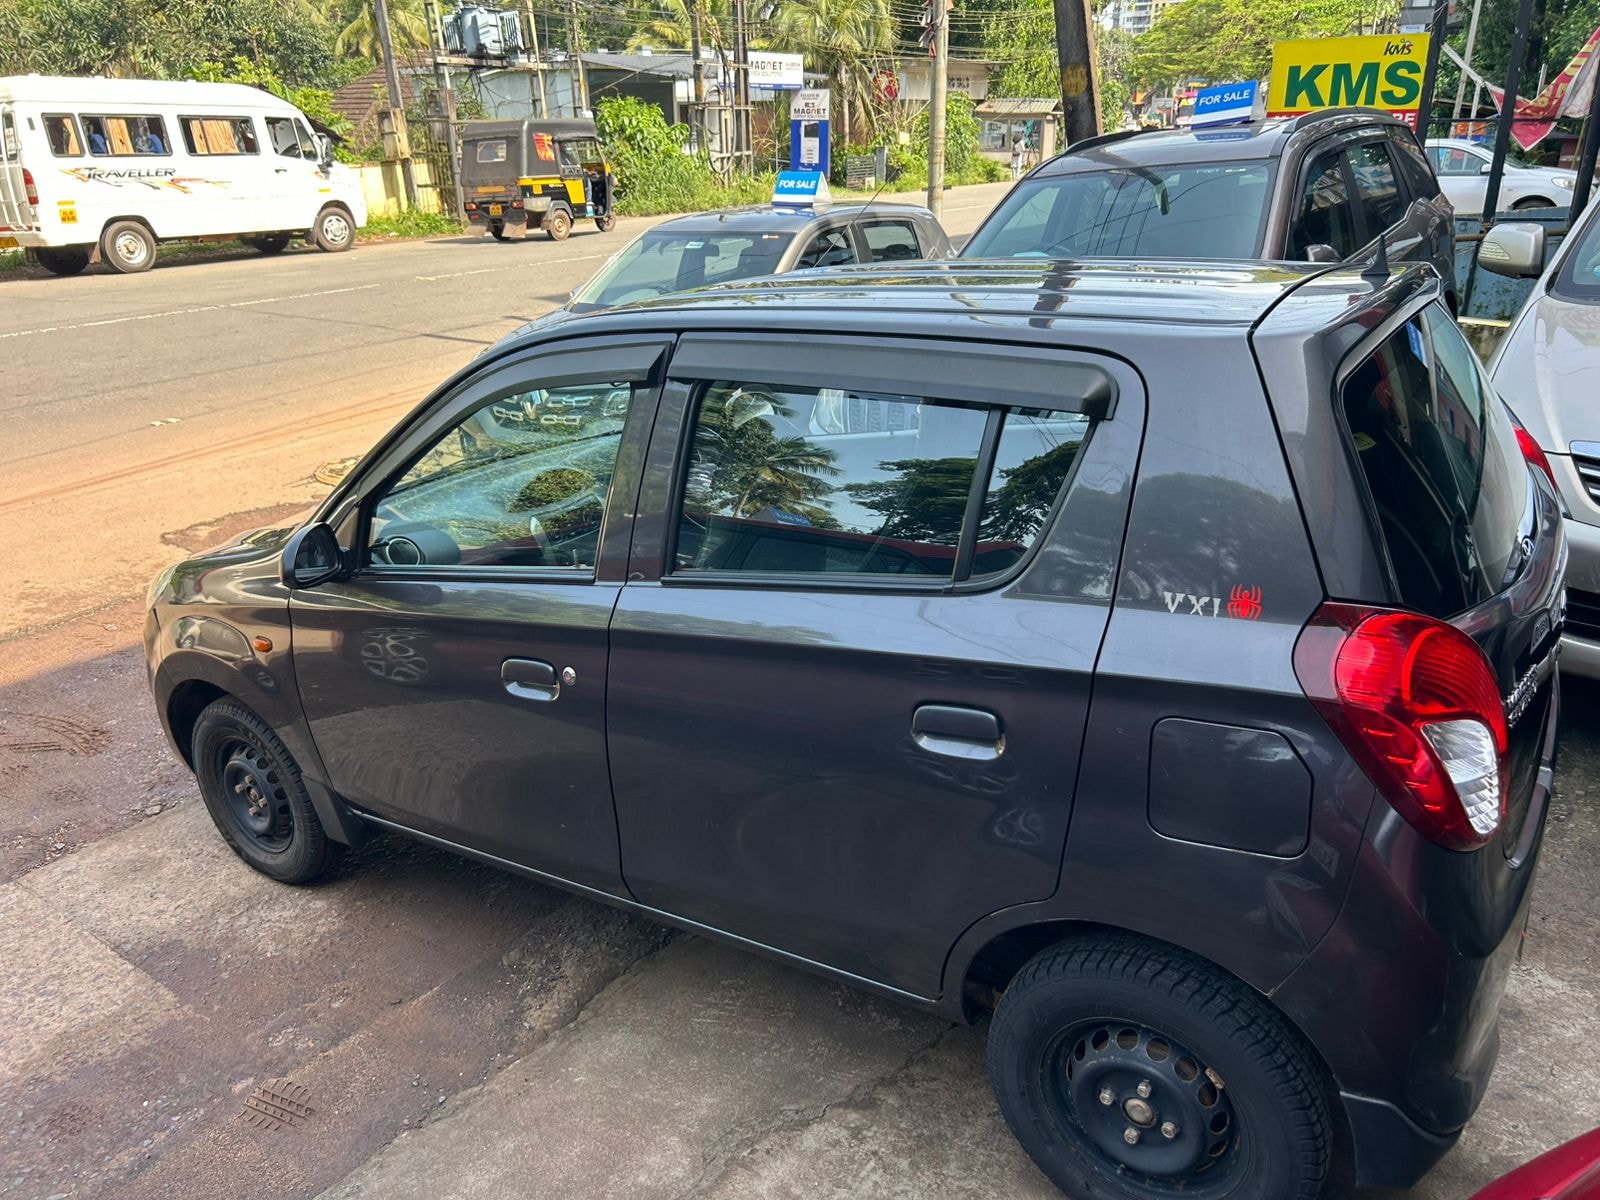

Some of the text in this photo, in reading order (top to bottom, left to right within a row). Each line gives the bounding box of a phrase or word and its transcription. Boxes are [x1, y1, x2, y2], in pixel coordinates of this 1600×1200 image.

[1284, 60, 1421, 108] KMS
[1199, 89, 1251, 106] FOR SALE
[85, 167, 176, 180] TRAVELLER
[779, 180, 816, 188] FOR SALE
[1163, 591, 1221, 618] VXI
